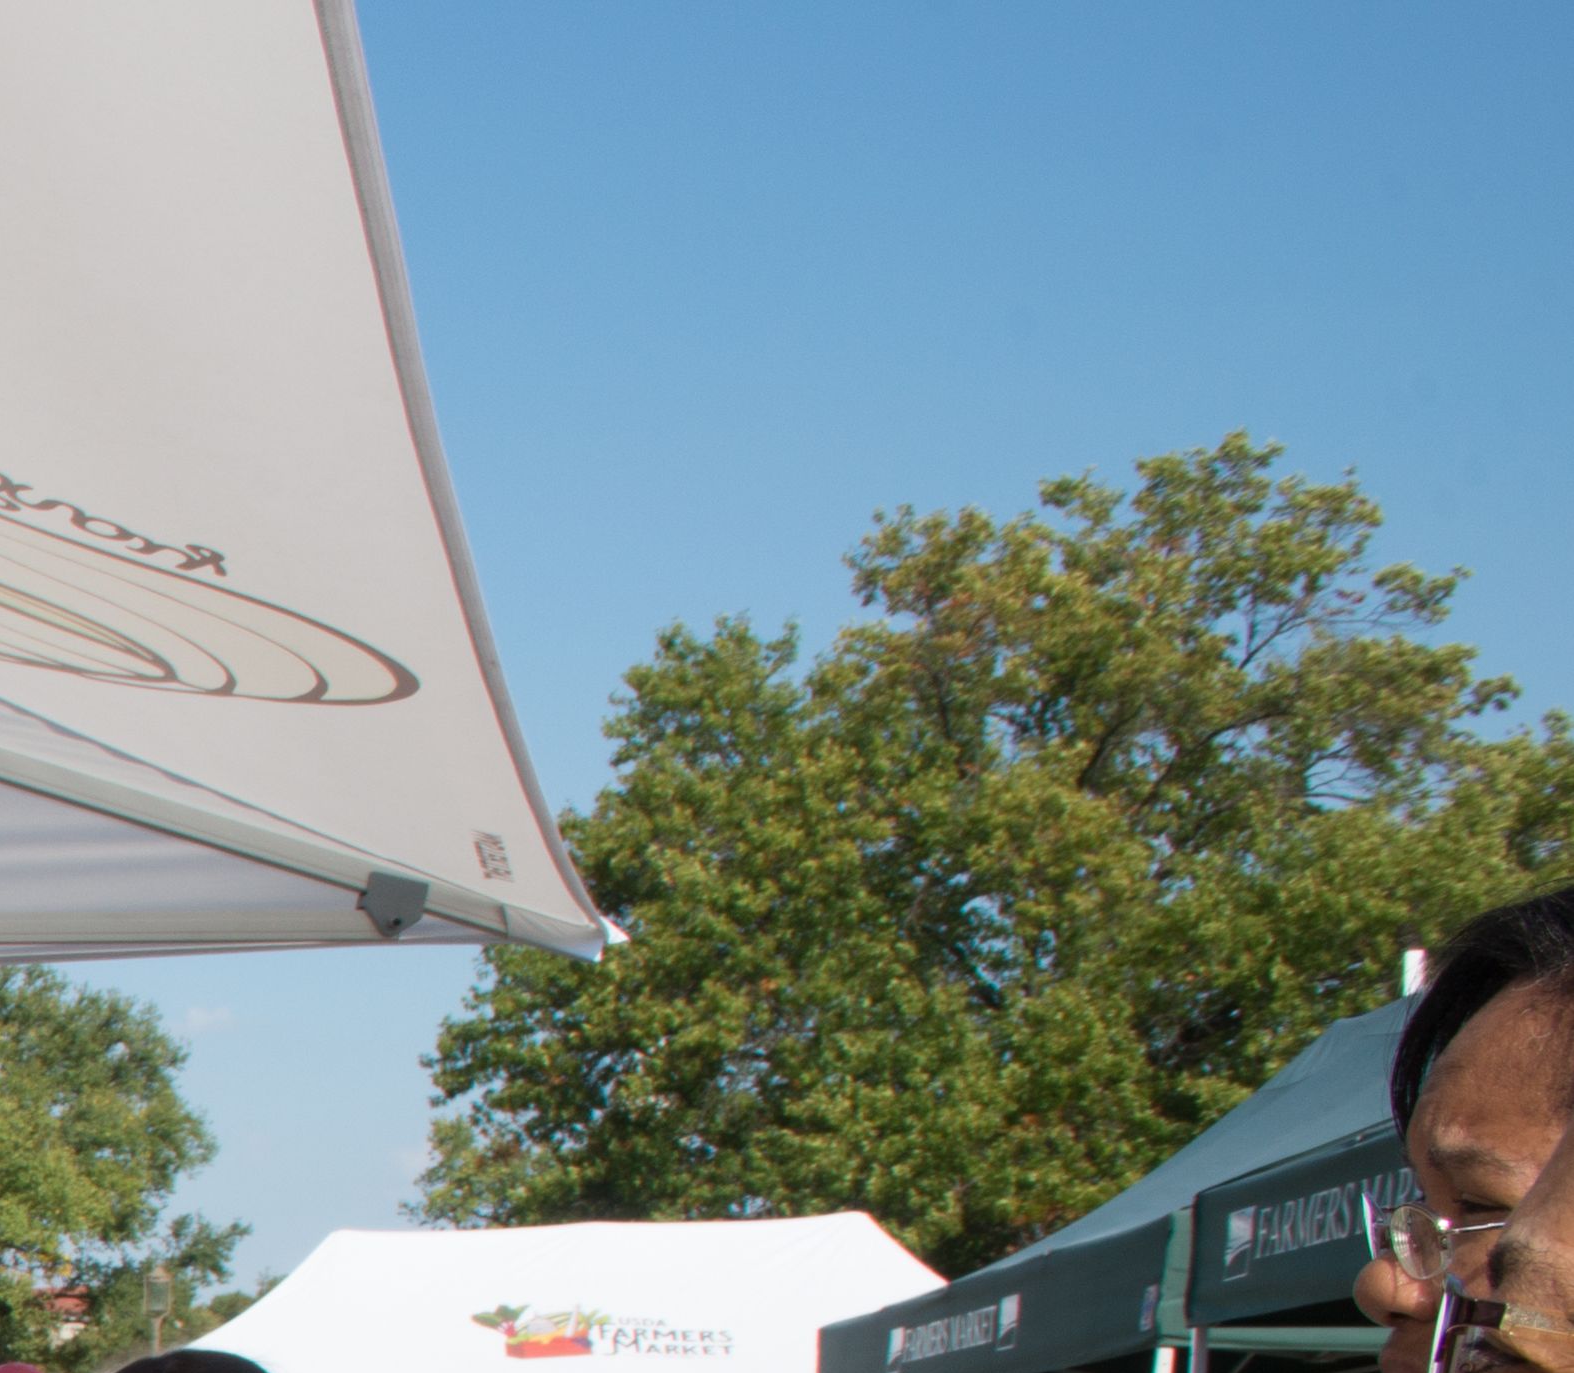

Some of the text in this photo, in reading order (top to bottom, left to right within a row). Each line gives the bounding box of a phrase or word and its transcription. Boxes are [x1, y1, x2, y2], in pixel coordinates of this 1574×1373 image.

[1254, 1182, 1355, 1260] FARMERS
[618, 1317, 667, 1328] USDA
[598, 1327, 734, 1342] FARMERS
[607, 1332, 735, 1356] MARKET
